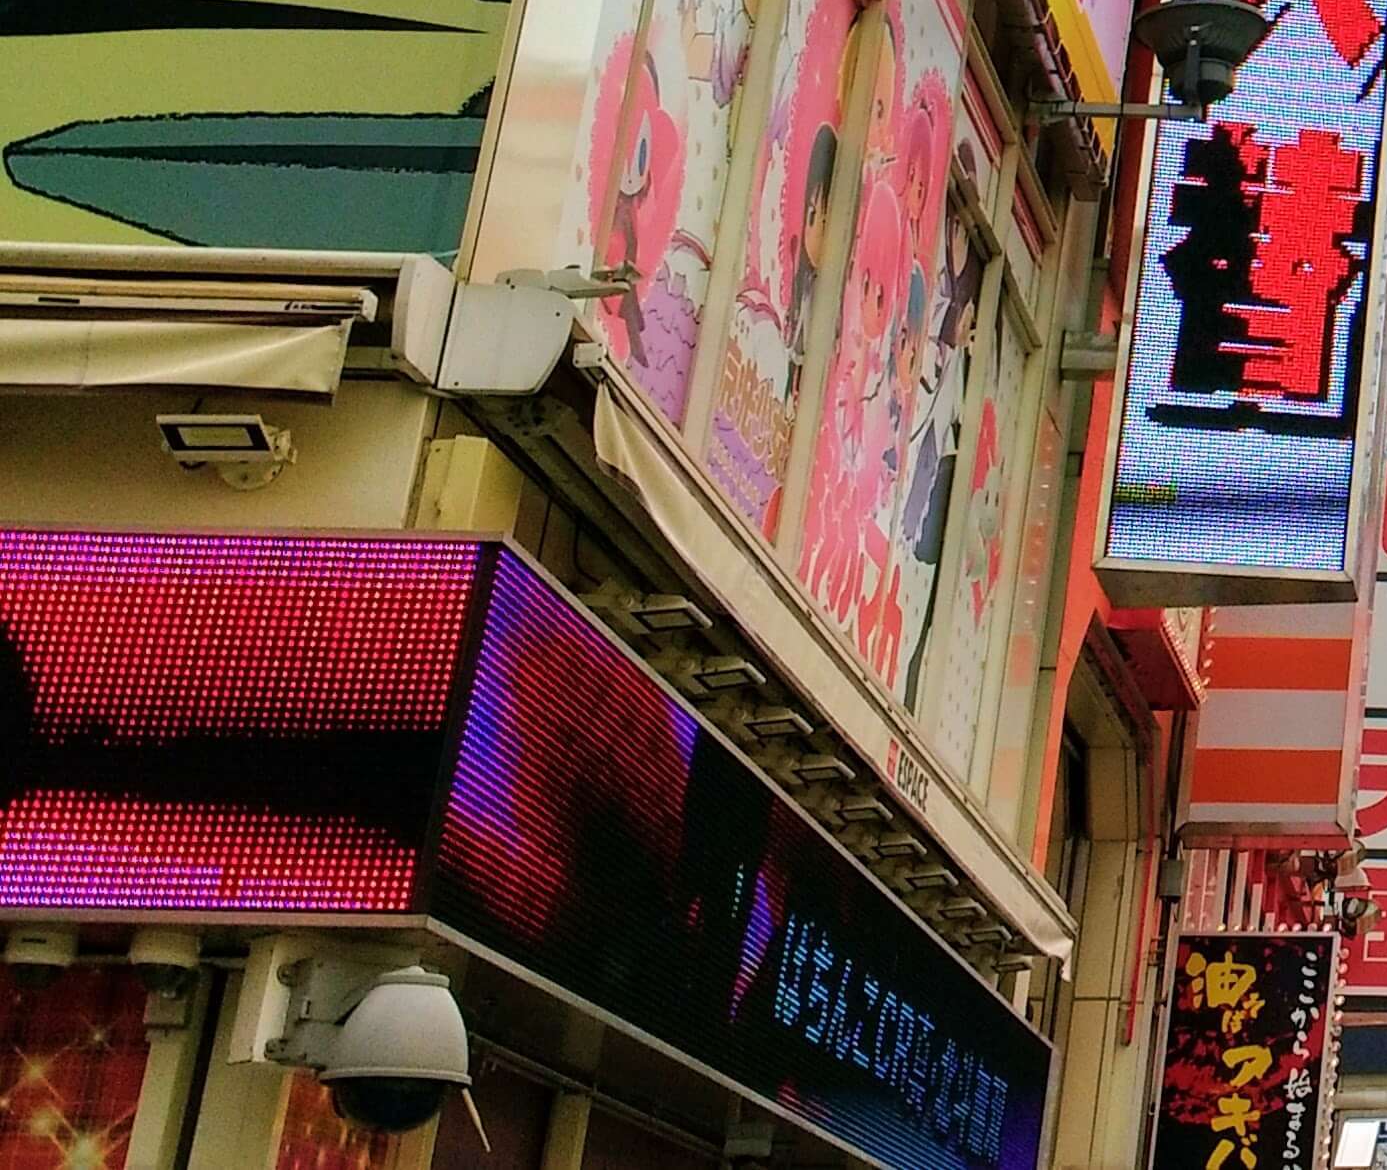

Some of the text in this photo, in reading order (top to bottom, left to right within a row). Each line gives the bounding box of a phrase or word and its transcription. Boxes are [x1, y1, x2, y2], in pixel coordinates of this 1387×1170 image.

[1186, 951, 1266, 1034] 油そば
[1283, 951, 1319, 1170] ここから始まる
